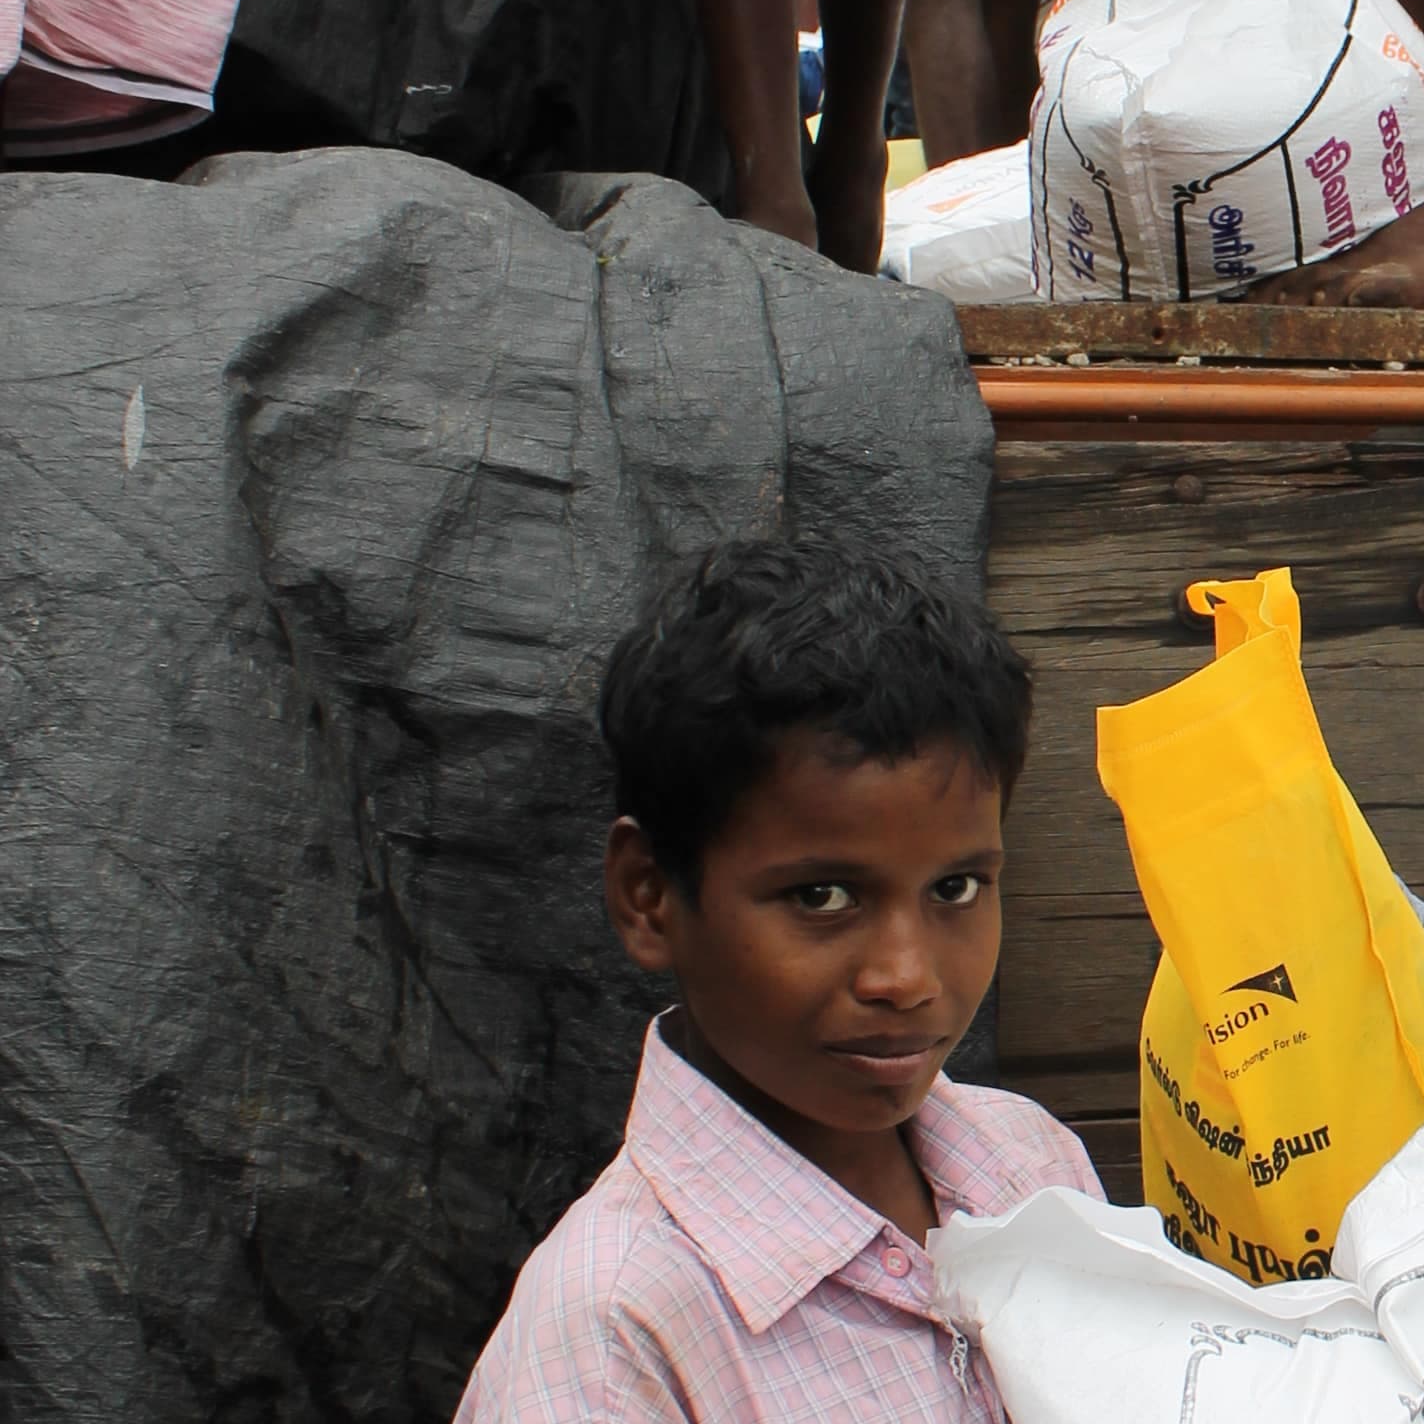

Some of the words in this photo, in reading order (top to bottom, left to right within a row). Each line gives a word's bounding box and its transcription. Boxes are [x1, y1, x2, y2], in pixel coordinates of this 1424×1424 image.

[1067, 241, 1097, 283] 12
[1204, 1001, 1270, 1046] ision
[1223, 1069, 1240, 1080] For
[1273, 1038, 1290, 1051] For
[1246, 1124, 1332, 1189] ந்தியா
